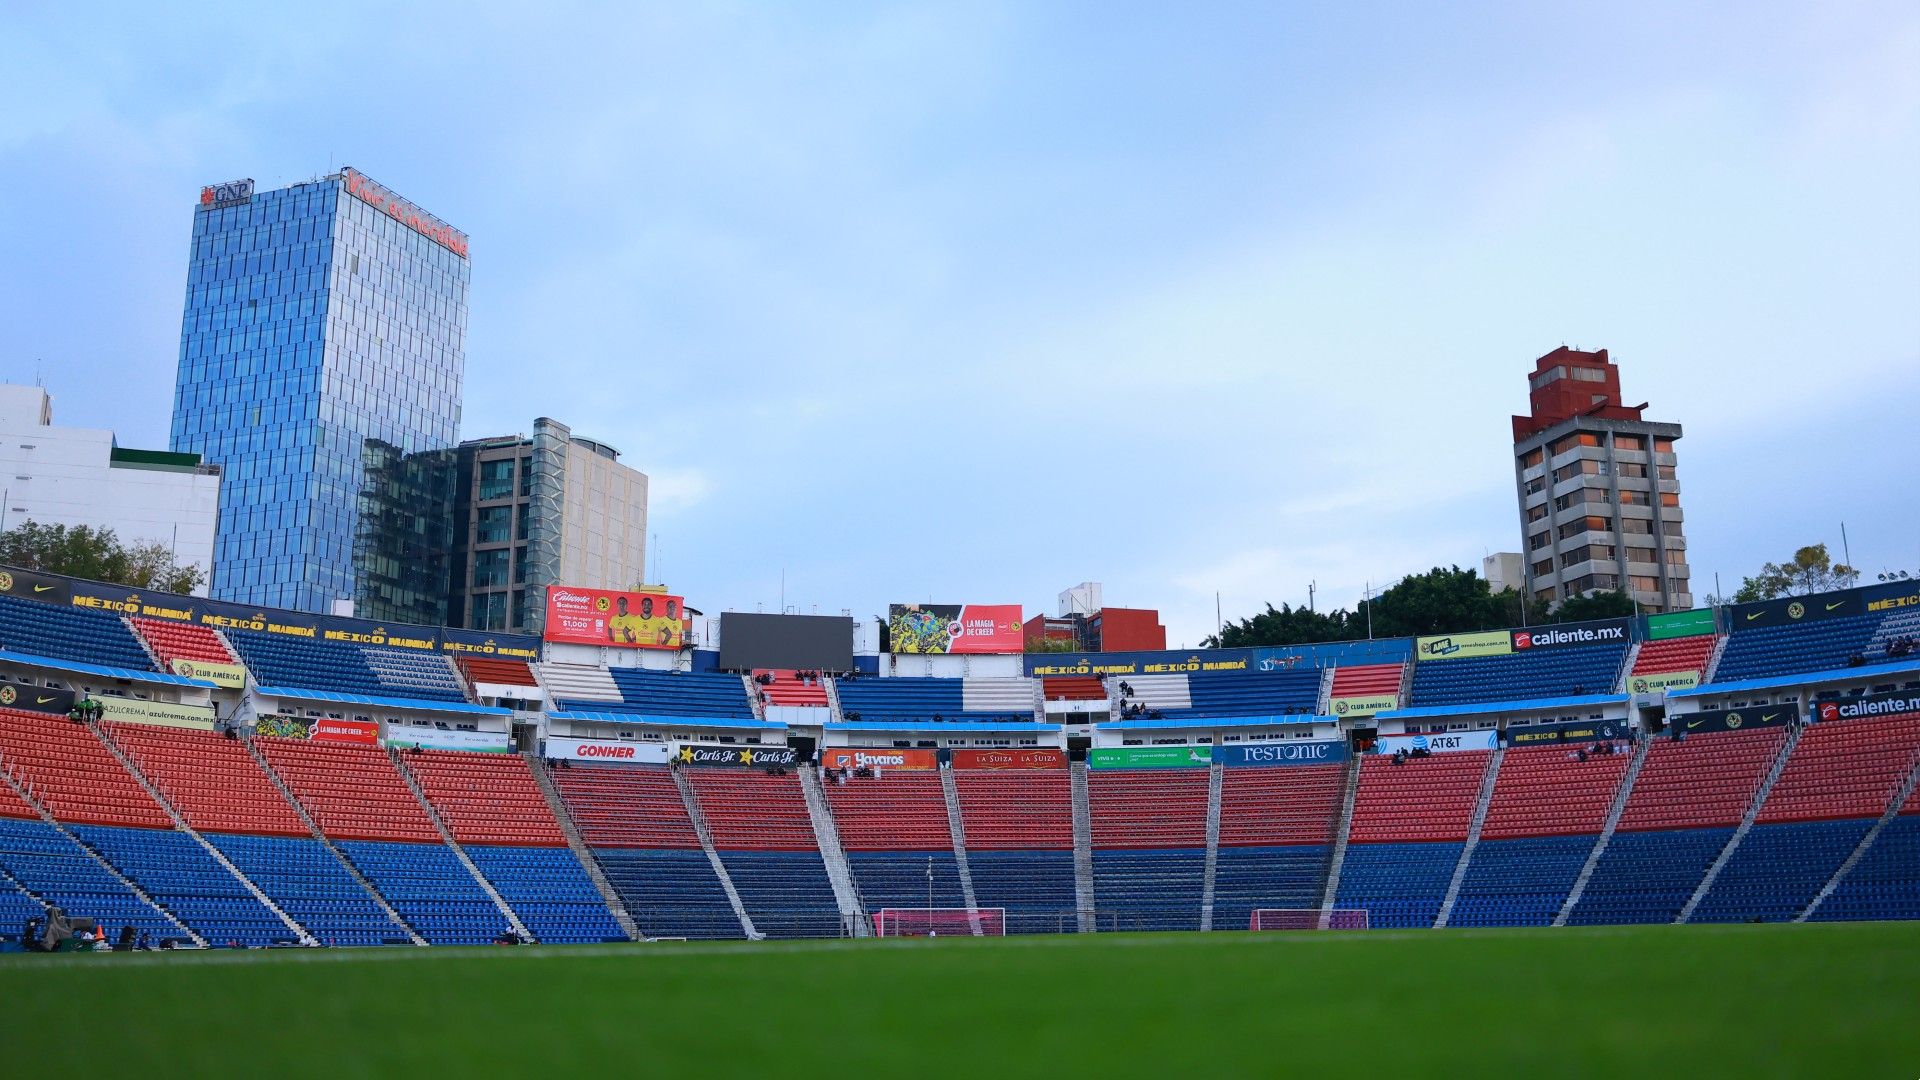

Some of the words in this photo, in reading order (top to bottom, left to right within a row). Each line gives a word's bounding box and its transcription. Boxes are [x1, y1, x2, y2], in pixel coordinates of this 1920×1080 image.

[215, 183, 248, 201] GNP
[72, 595, 139, 613] MÉXICO
[1867, 594, 1920, 612] MÉXIC
[201, 614, 264, 631] MÉXICO
[562, 620, 588, 628] $1,000
[966, 620, 975, 628] LA
[976, 620, 994, 628] MAGIA
[324, 630, 385, 644] MÉXICO
[1532, 627, 1623, 646] caliente.mx
[1034, 666, 1089, 675] MÉXICO
[1144, 663, 1200, 673] MÉXICO
[195, 669, 211, 677] CLUB
[212, 671, 240, 681] AMÉRICA
[103, 705, 146, 716] AZULCREMA
[148, 711, 214, 724] azulcrema.com.mx
[1430, 736, 1461, 749] AT&T
[576, 744, 635, 758] GONHER
[693, 749, 720, 762] Carl's
[721, 750, 735, 762] Jr.
[752, 751, 780, 763] Carl's
[780, 752, 794, 764] Jr.
